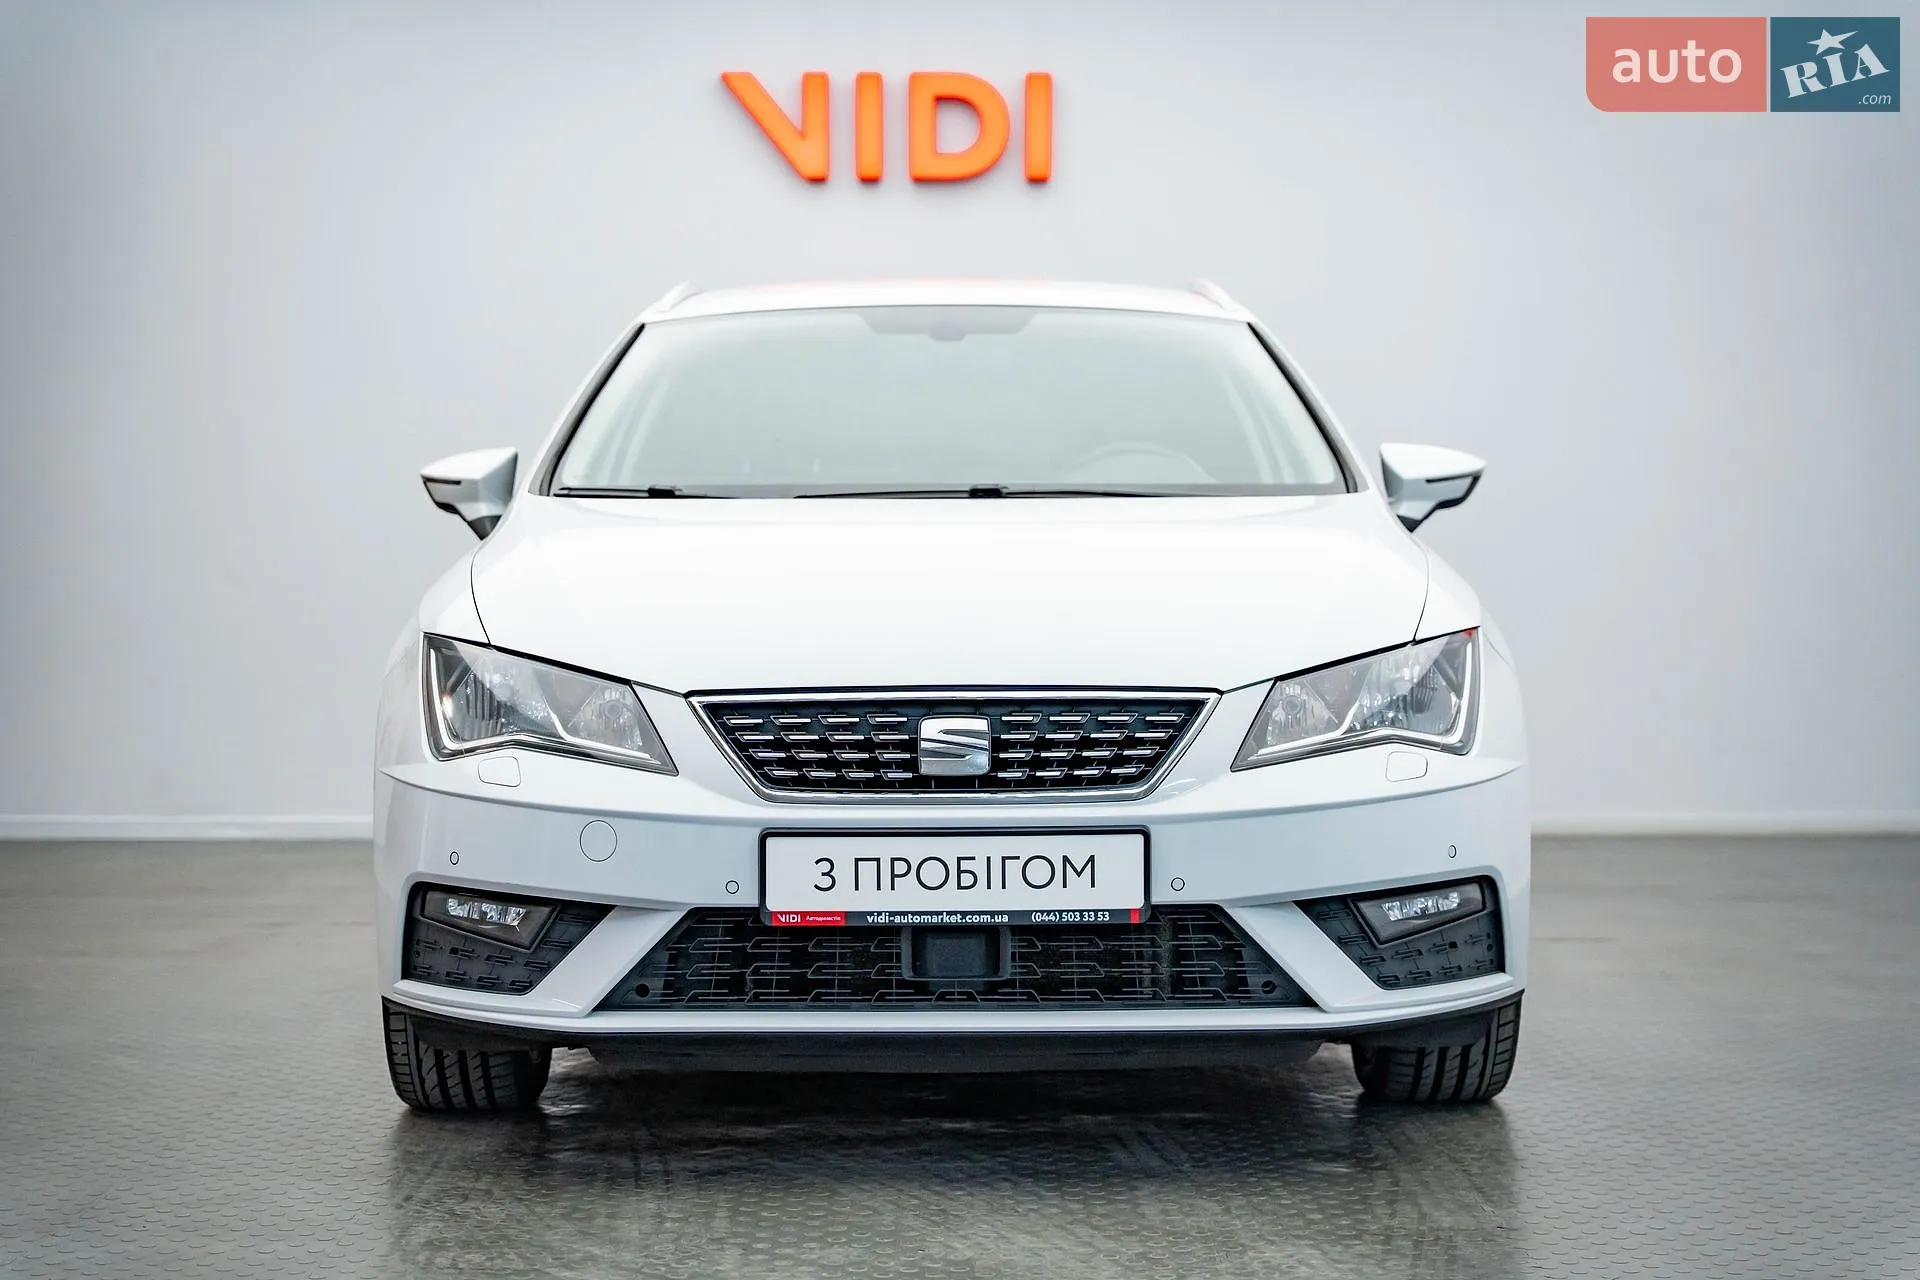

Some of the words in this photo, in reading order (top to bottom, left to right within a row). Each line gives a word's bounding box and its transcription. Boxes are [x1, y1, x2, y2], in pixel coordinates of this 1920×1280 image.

[721, 71, 1053, 182] VIDI
[854, 854, 1096, 891] ПРОБІГОМ
[777, 914, 801, 923] VIDI
[866, 912, 1009, 923] vidi-automarket.com.ua
[1031, 912, 1060, 923] (044)
[1061, 912, 1081, 922] 503
[1082, 911, 1096, 922] 33
[1097, 911, 1110, 922] 53
